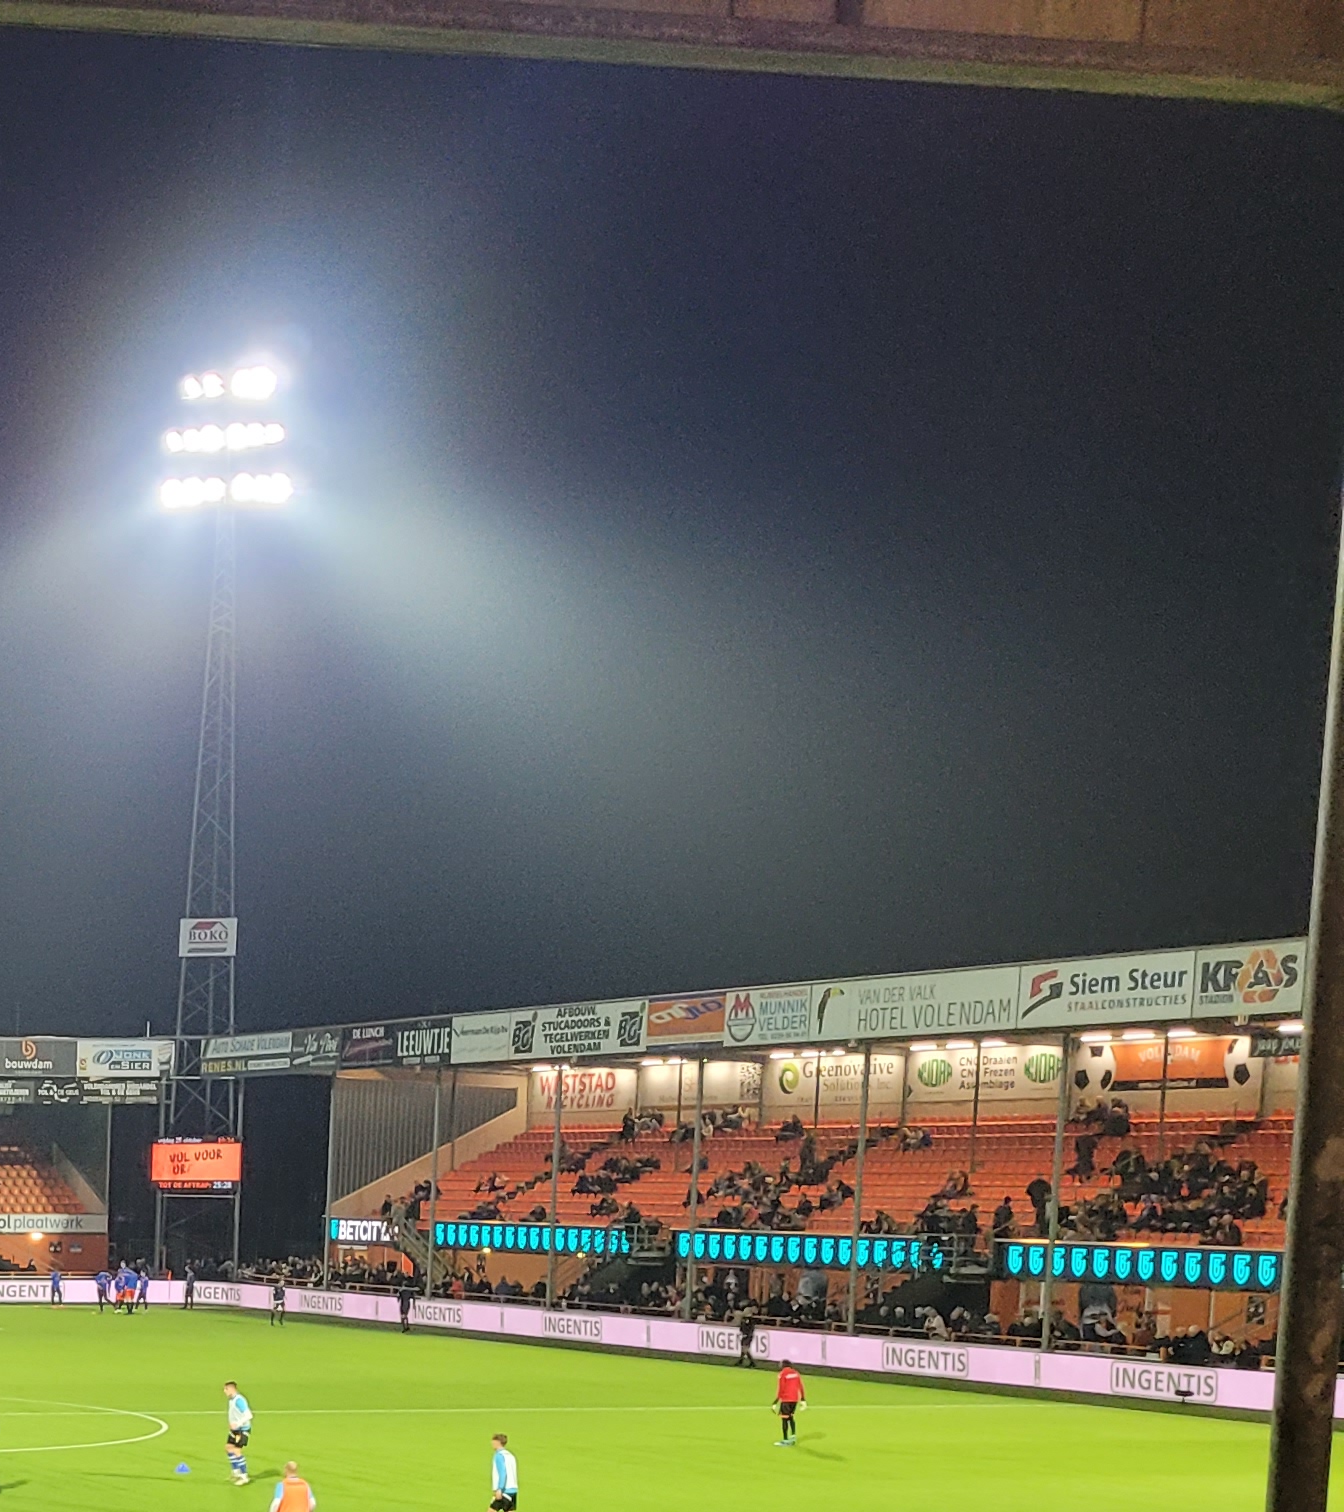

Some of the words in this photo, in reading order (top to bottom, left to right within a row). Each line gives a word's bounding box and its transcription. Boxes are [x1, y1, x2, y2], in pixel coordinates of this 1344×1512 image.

[189, 929, 228, 940] BOKO
[1068, 972, 1120, 996] Siem
[1127, 968, 1187, 991] Steur
[858, 988, 881, 1004] VAN
[884, 986, 904, 1003] DER
[909, 984, 936, 1001] VALK
[760, 999, 807, 1016] MUNNIK
[1067, 994, 1187, 1012] STAALCONSTRUCTIES
[858, 1006, 908, 1032] HOTEL
[913, 998, 1011, 1029] VOLENDAM
[541, 1017, 601, 1032] STUCADOORS
[758, 1016, 807, 1032] VELDER
[397, 1028, 450, 1056] LEEUWTJE
[543, 1029, 609, 1043] TEGELWERKEN
[550, 1041, 601, 1055] VOLENDAM
[5, 1059, 52, 1070] bouwdam
[121, 1062, 150, 1070] SIER
[201, 1060, 247, 1073] RENES.NL
[982, 1055, 1018, 1066] Draaien
[984, 1067, 1015, 1078] Frezen
[540, 1072, 616, 1095] WSTSTAD
[545, 1094, 614, 1110] RCYCLING
[13, 1216, 83, 1233] plaatwerk
[194, 1285, 240, 1302] NGENTIS
[300, 1293, 343, 1312] INGENTIS
[414, 1302, 462, 1325] INGENTIS
[544, 1313, 601, 1337] INGENTIS
[700, 1330, 768, 1355] INGEIS
[885, 1346, 967, 1373] INGENTIS
[1115, 1370, 1215, 1397] INGENTIS
